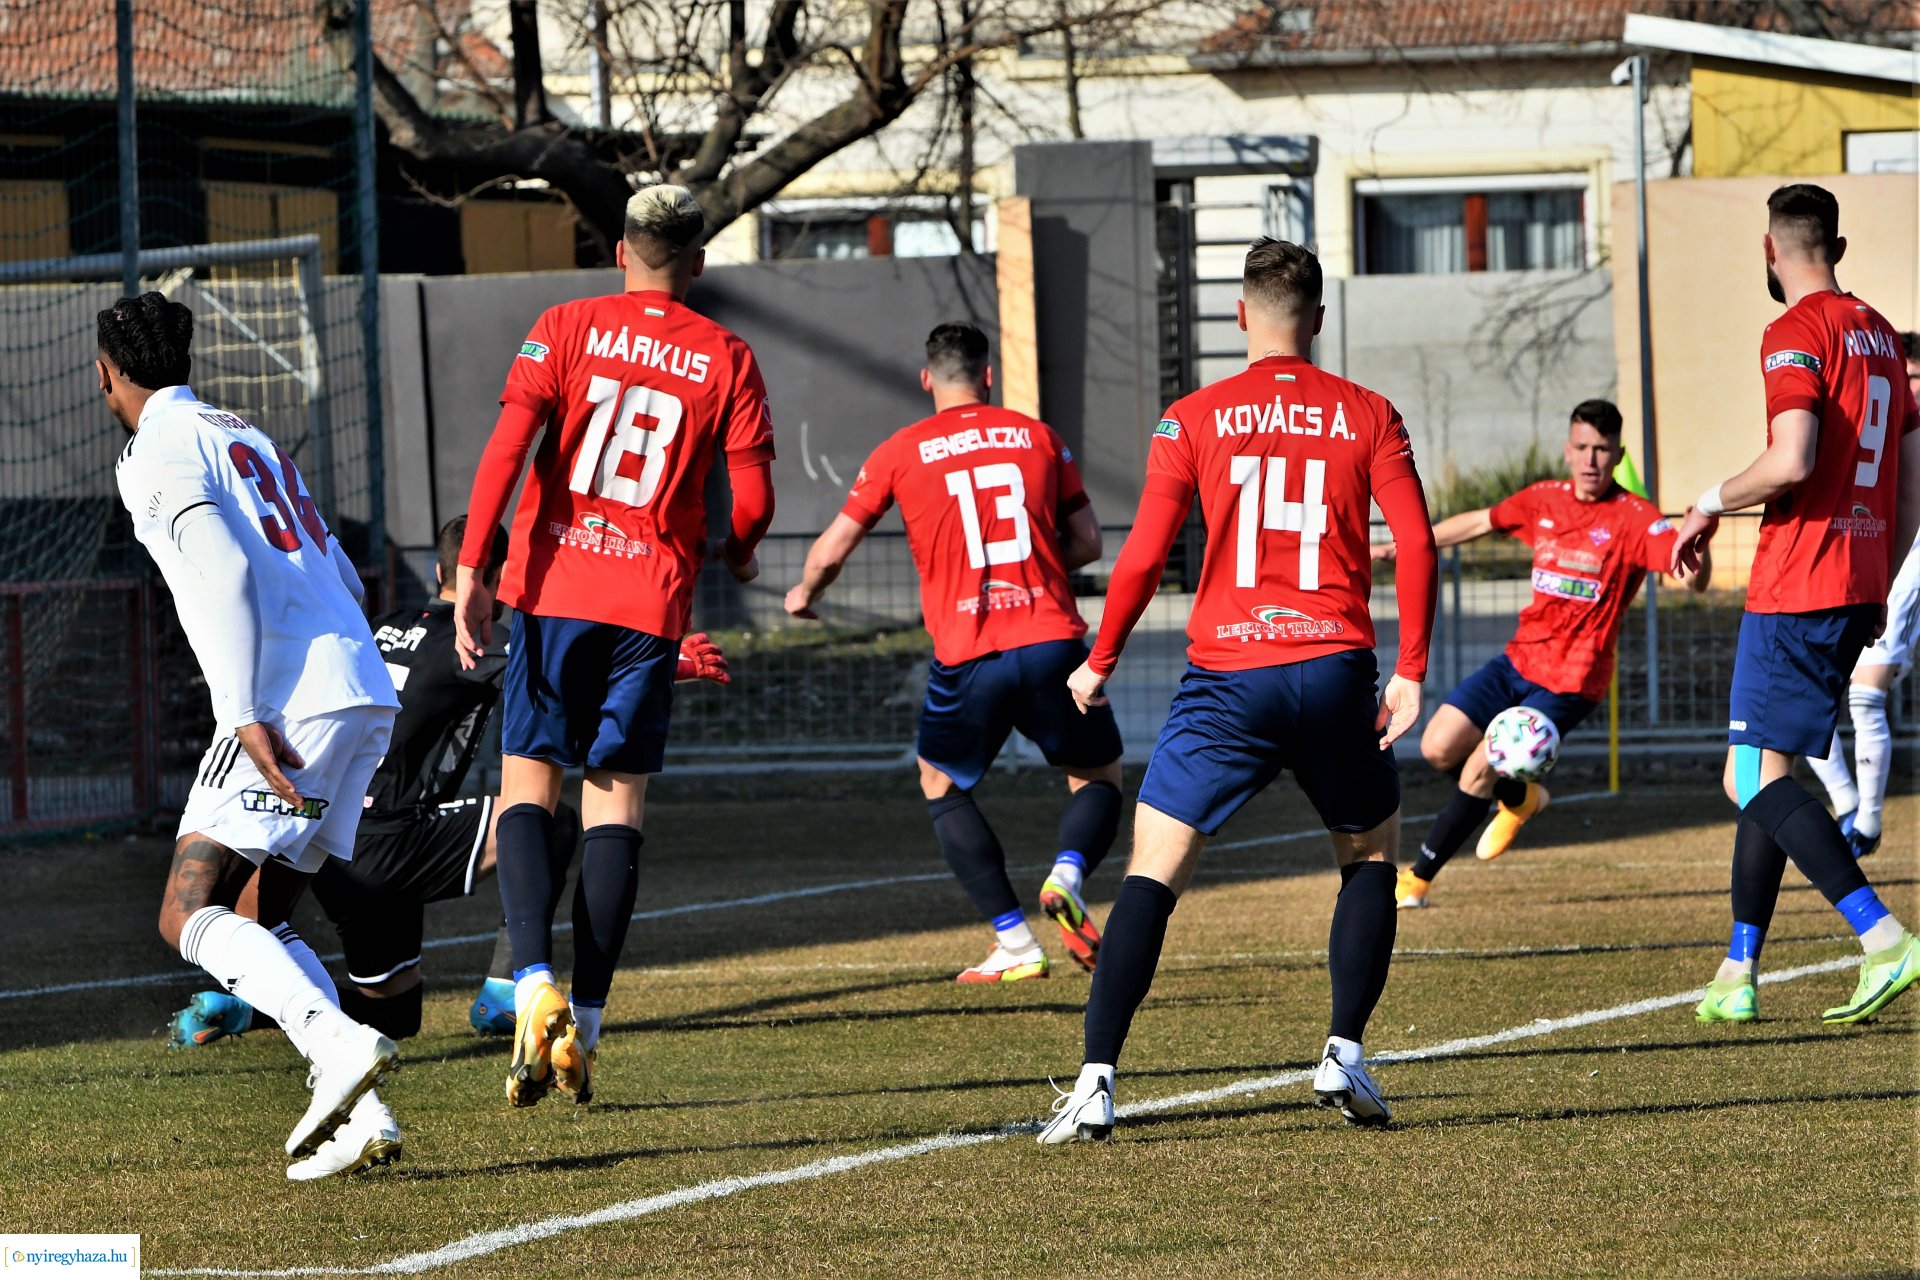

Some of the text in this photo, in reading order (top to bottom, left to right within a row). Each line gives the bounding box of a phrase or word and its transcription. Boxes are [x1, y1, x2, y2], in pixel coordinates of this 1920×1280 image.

[585, 326, 711, 384] MÁRKUS
[568, 374, 683, 508] 18
[918, 427, 1033, 464] GENGELICZKI
[1214, 395, 1356, 440] KOVÁCS Á.
[1854, 375, 1891, 489] 9
[228, 440, 328, 558] 34
[549, 522, 602, 546] ERTON
[944, 462, 1033, 569] 13
[1229, 455, 1328, 591] 14
[1216, 622, 1286, 639] LERTON
[1287, 620, 1344, 636] TRANS
